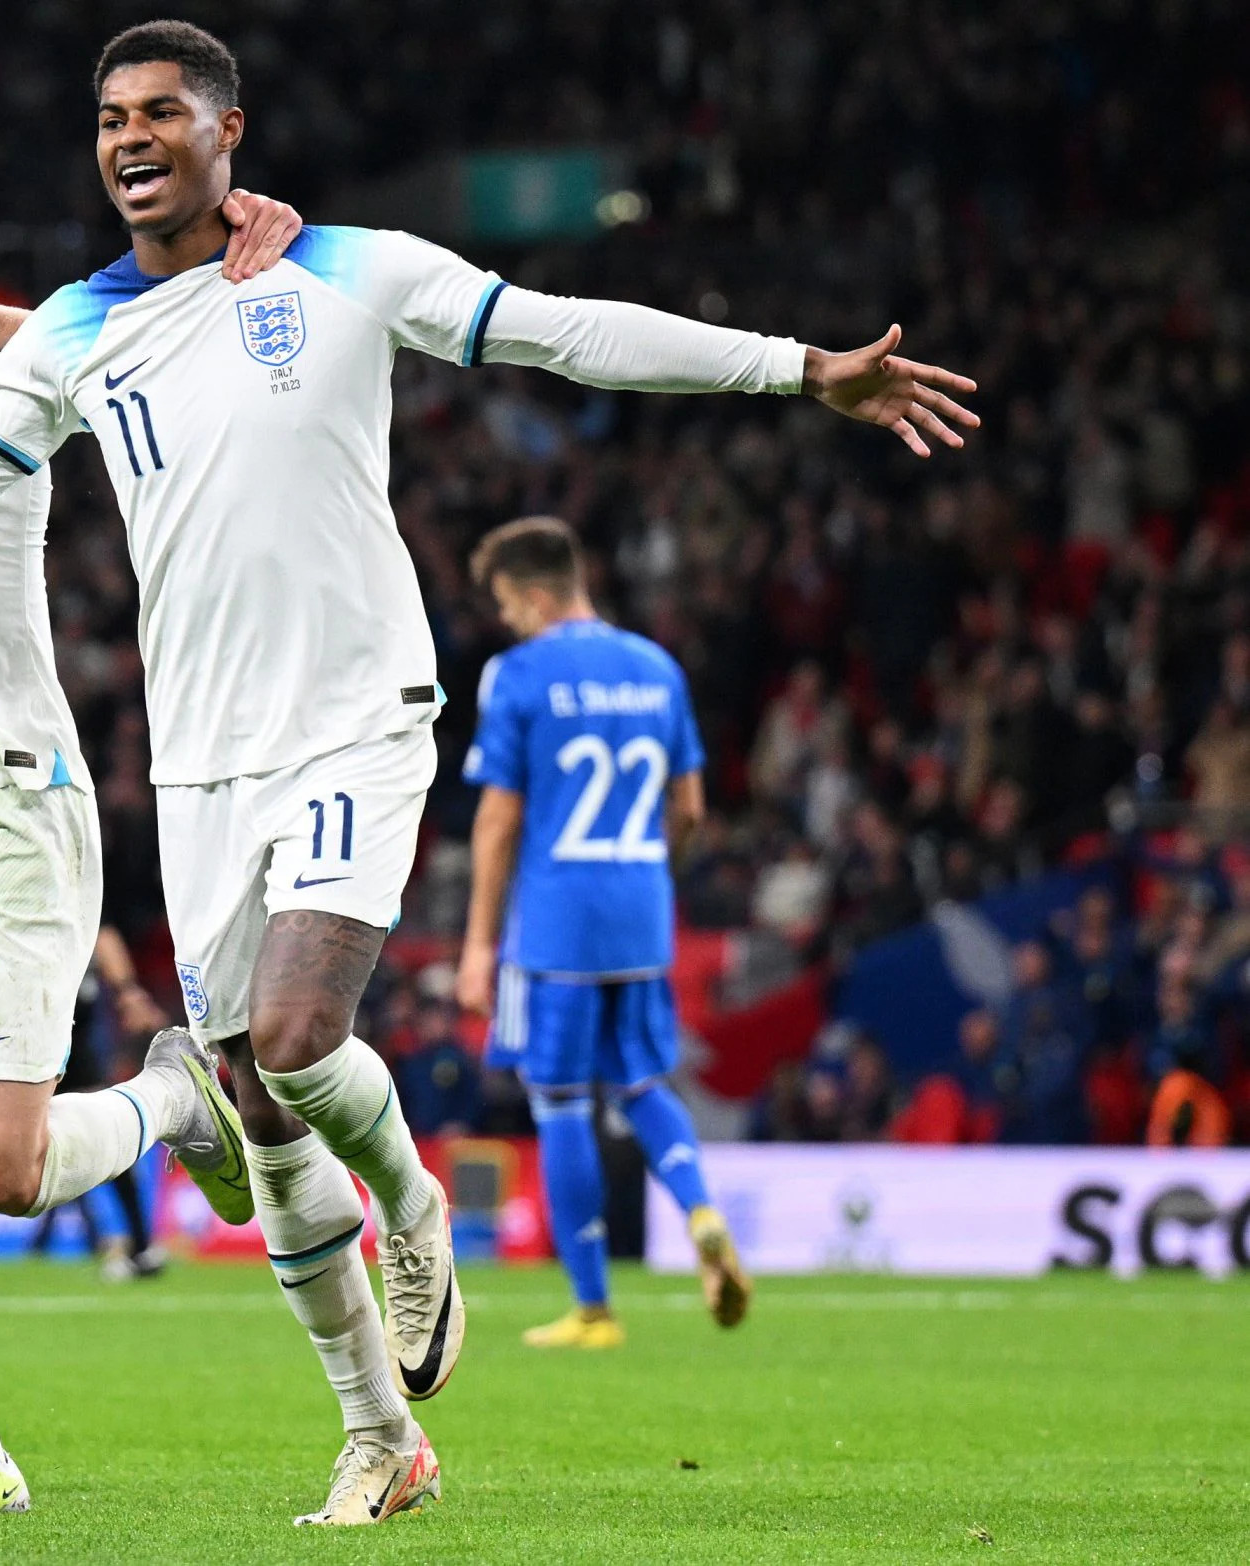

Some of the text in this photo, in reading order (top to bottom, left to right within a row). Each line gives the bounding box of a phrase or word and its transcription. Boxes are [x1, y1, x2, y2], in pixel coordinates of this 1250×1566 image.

[106, 390, 165, 477] 11
[307, 791, 354, 861] 11
[551, 734, 669, 863] 22
